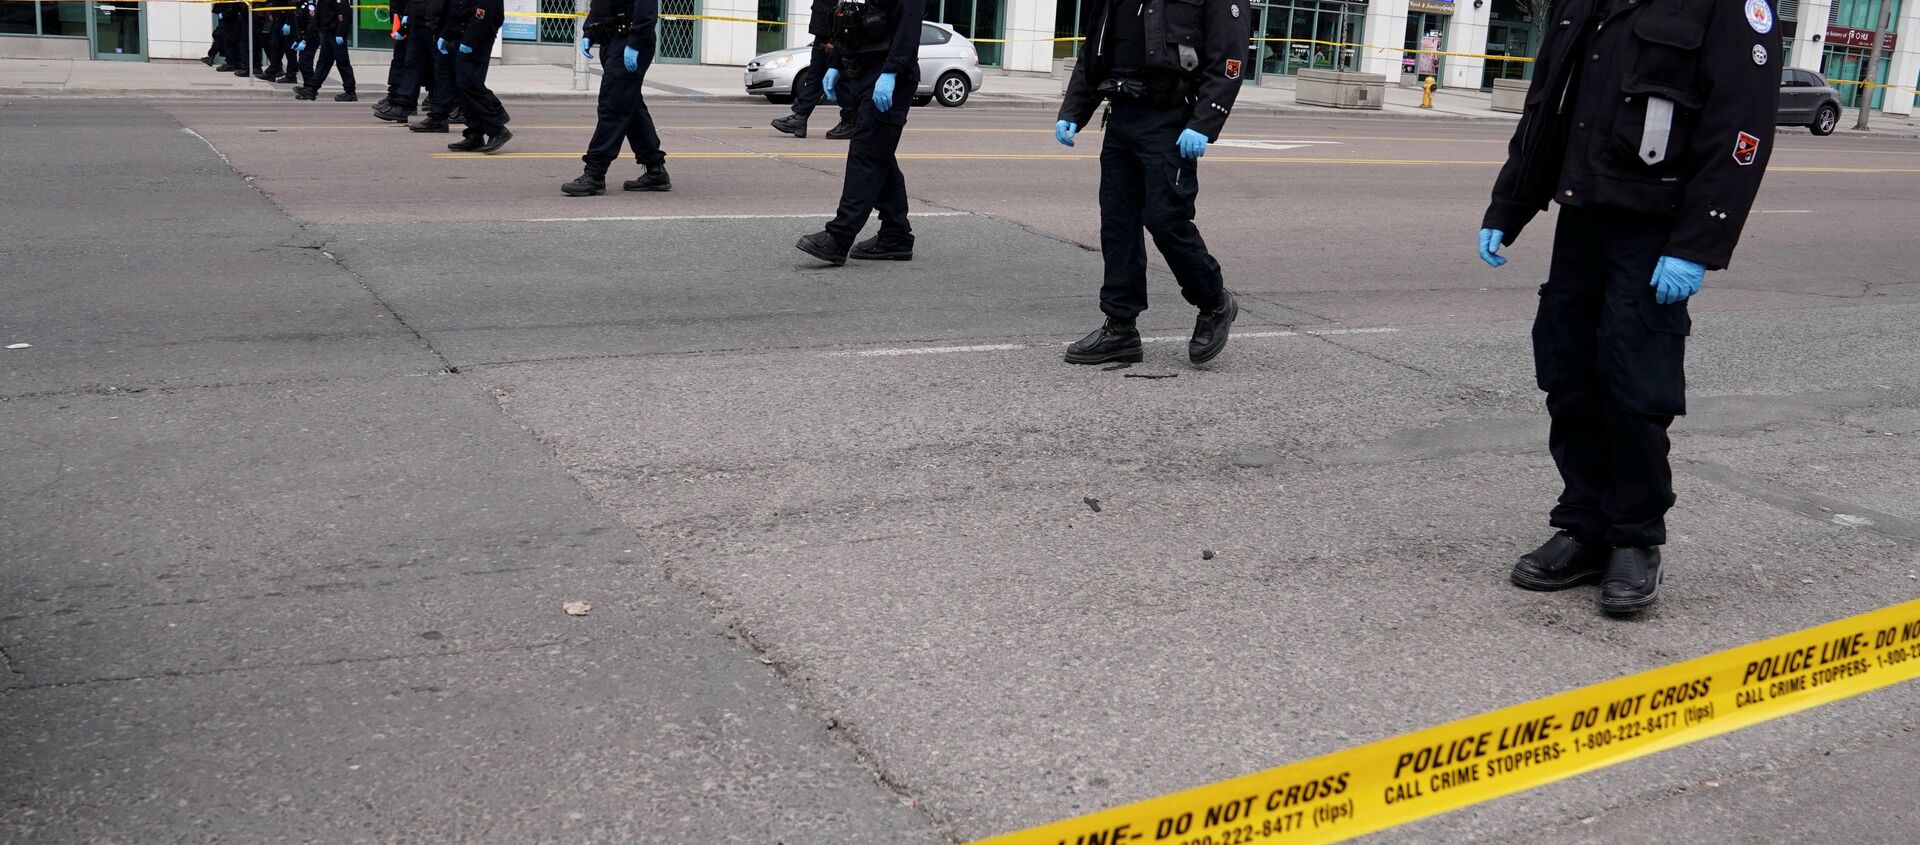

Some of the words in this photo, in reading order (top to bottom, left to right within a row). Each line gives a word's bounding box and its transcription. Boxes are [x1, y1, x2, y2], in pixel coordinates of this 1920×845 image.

[1736, 686, 1764, 708] CALL
[1769, 674, 1806, 699] CRIME
[1811, 657, 1872, 687] STOPPERS-
[1743, 645, 1816, 685] POLICE
[1820, 632, 1869, 664] LINE-
[1874, 627, 1897, 649] DO
[1384, 784, 1423, 805] CALL
[1430, 765, 1480, 793] CRIME
[1487, 741, 1566, 778] STOPPERS-
[1574, 711, 1678, 754] 1-800-222-8477
[1684, 701, 1715, 728] (tips)
[1394, 731, 1492, 778] POLICE
[1498, 715, 1563, 752] LINE-
[1570, 707, 1599, 732] DO
[1605, 694, 1645, 723] NOT
[1649, 676, 1713, 711] CROSS
[1154, 812, 1193, 841] DO
[1204, 796, 1259, 829] NOT
[1265, 771, 1351, 812] CROSS
[1312, 799, 1354, 828] (tips)
